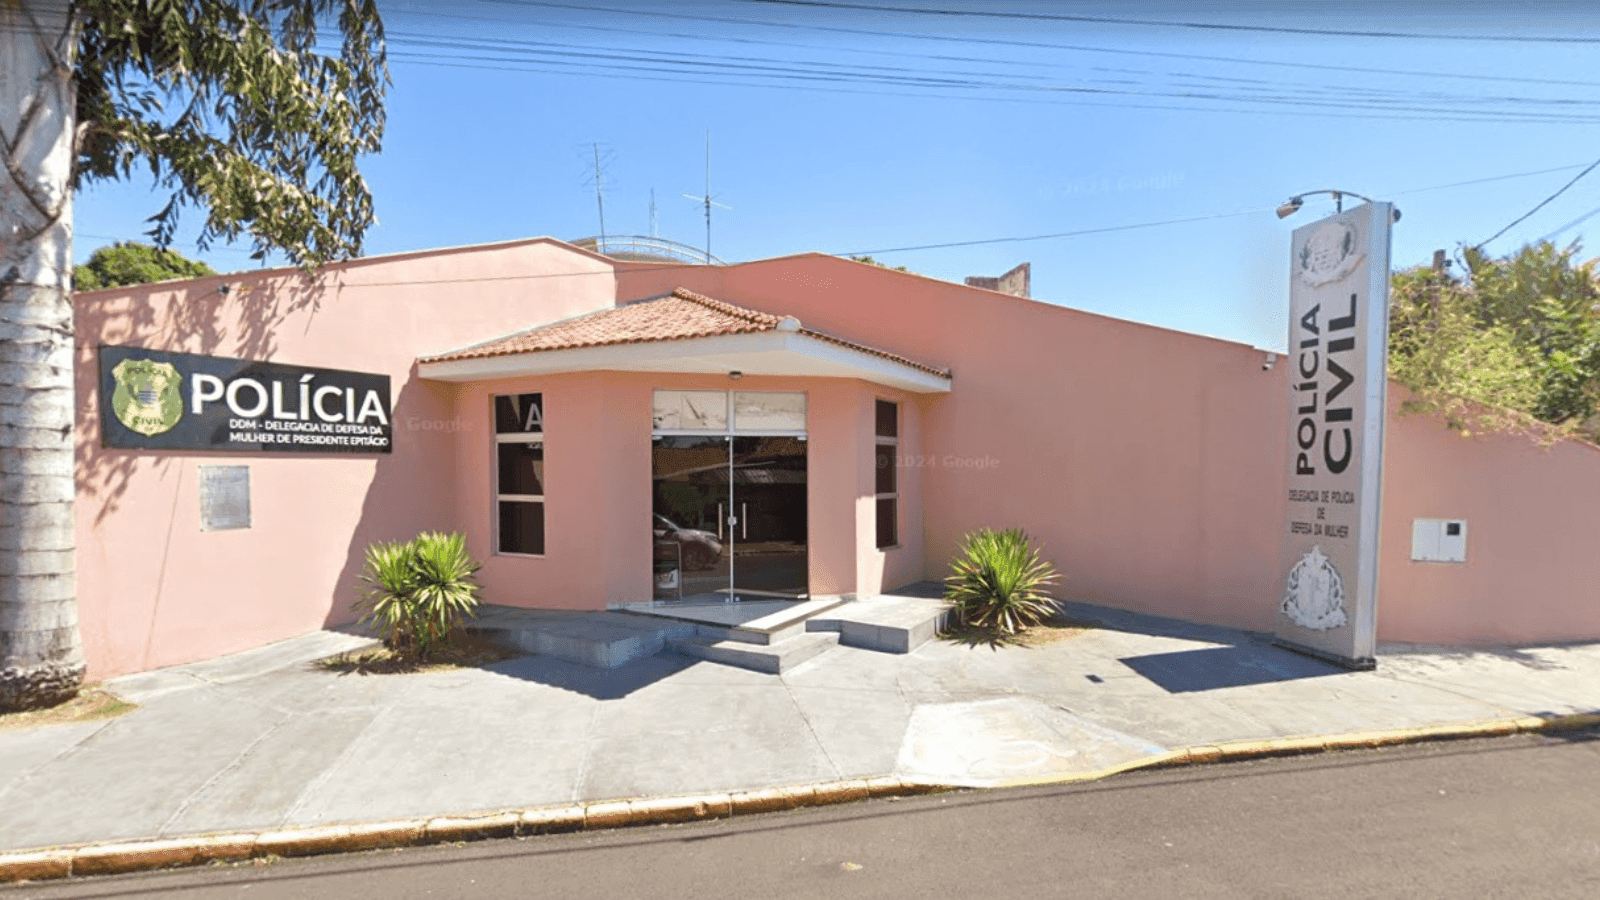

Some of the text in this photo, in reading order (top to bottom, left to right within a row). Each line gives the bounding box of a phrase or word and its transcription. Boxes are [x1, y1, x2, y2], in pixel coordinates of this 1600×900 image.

[1293, 302, 1321, 476] POLÍCIA
[1323, 293, 1357, 475] CIVIL
[191, 373, 388, 425] POLÍCIA
[229, 418, 256, 429] DDM
[265, 421, 321, 433] DELEGACIA
[321, 423, 334, 433] DE
[335, 424, 369, 434] DEFESA
[369, 426, 383, 435] DA
[229, 431, 389, 446] MULHER DE PRESIDENTE EPITÁCIO
[1320, 490, 1330, 503] DE
[1316, 507, 1325, 520] DE
